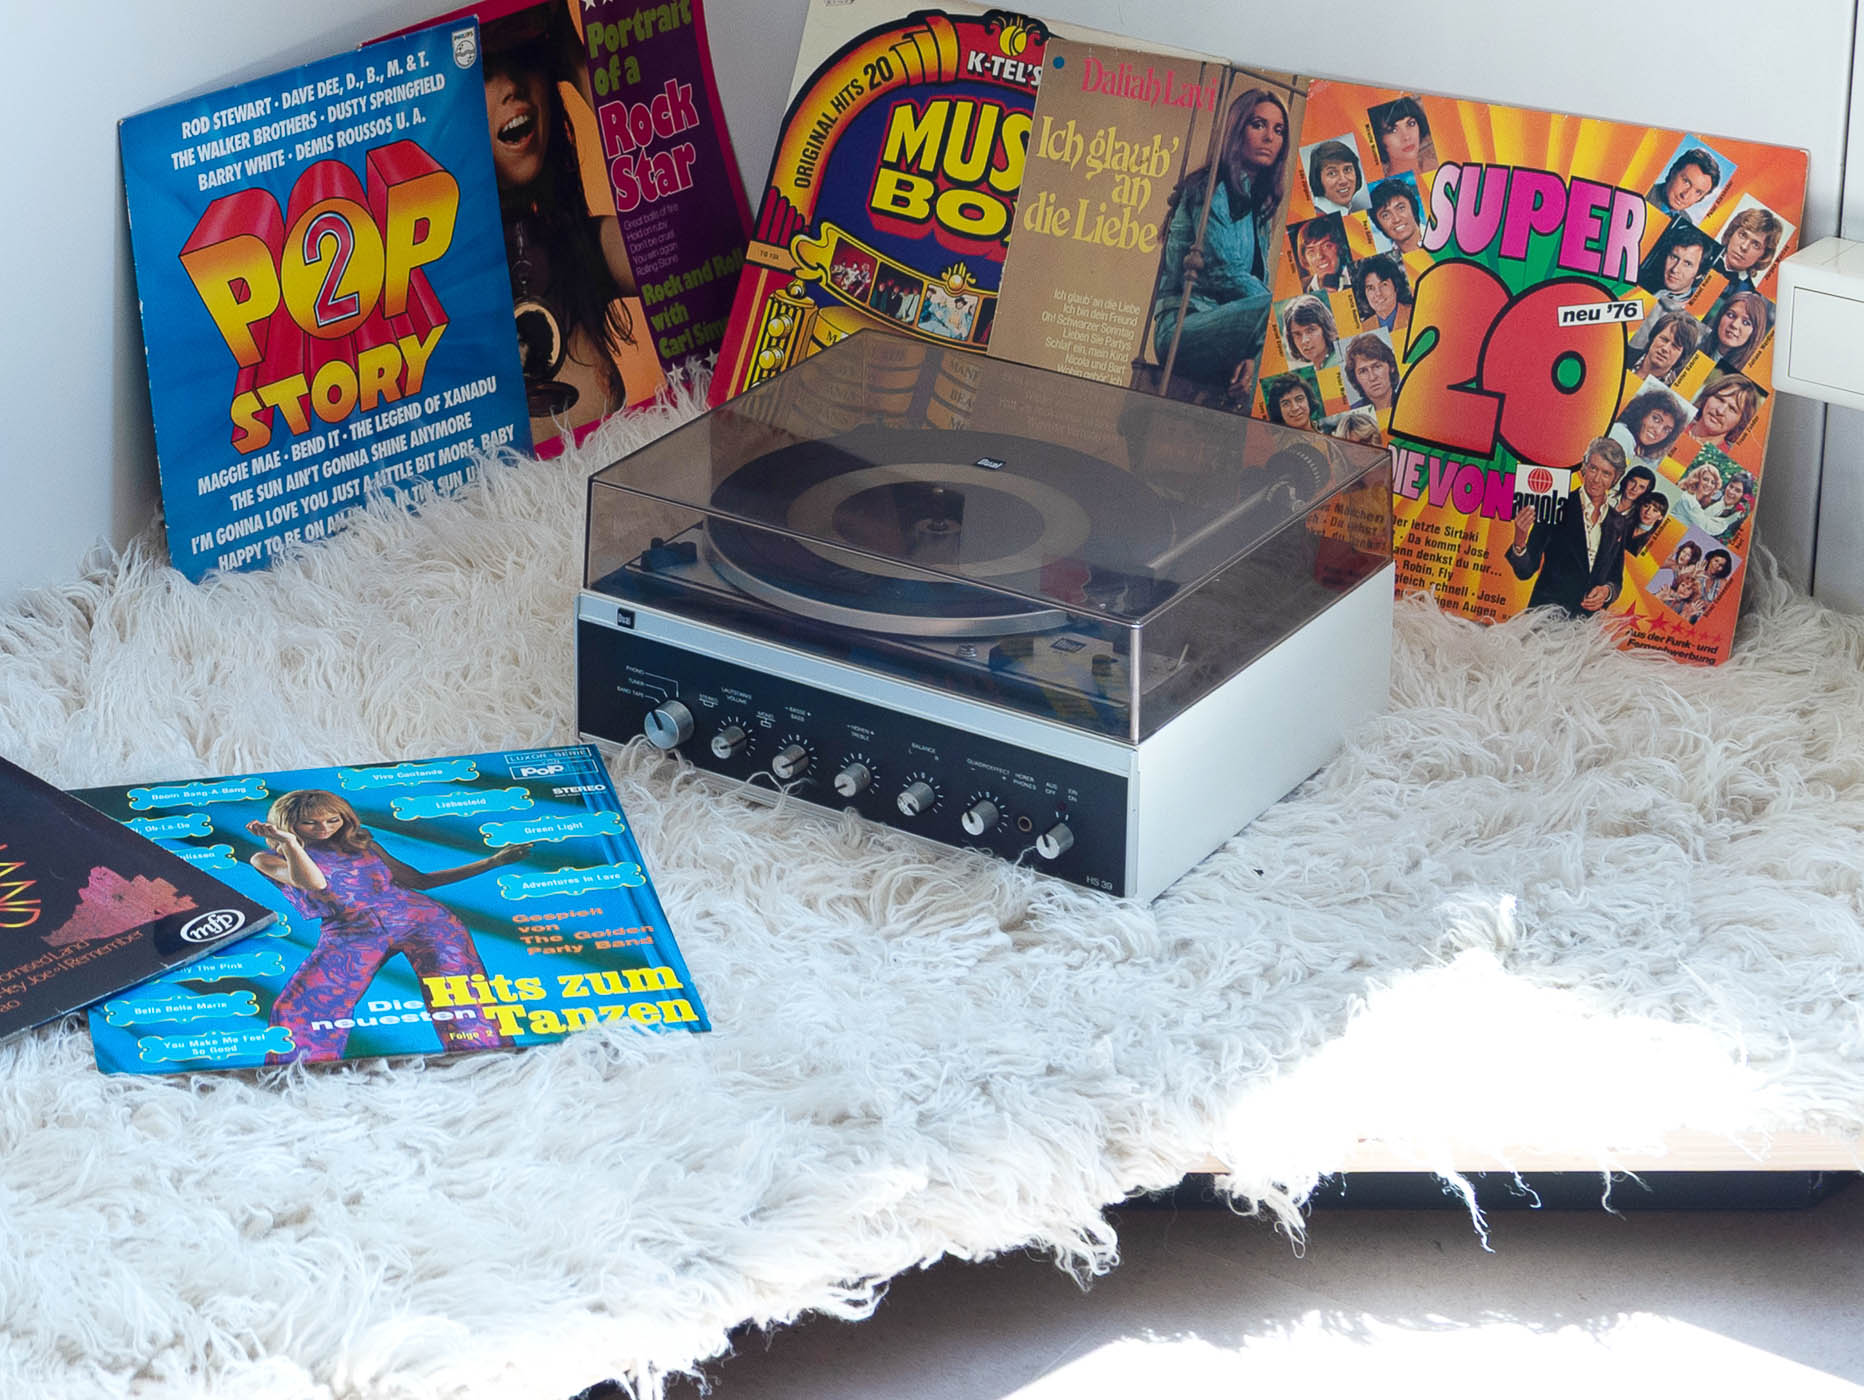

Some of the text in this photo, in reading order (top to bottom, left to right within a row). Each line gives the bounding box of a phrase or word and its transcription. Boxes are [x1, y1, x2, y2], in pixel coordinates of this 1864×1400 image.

[594, 55, 641, 96] of a
[968, 50, 1042, 87] K-TEL'S
[181, 52, 430, 139] ROD STEWART DAVE DEE, D., B., M. T.
[1081, 56, 1217, 112] Daliah Lavi
[171, 73, 445, 170] THE WALKER BROTHERS DUSTY SPRINGFIELD
[599, 78, 699, 159] Rock
[794, 56, 894, 189] ORIGINAL HITS 20
[198, 107, 426, 191] BARRY WHITE DEMIS ROUSSOS U. A.
[883, 100, 1033, 193] MUS
[1037, 116, 1180, 181] Ich glaub'
[611, 142, 696, 212] Star
[869, 166, 1018, 242] BO
[1112, 174, 1151, 214] an
[1023, 192, 1158, 253] die Liebe
[1421, 162, 1647, 285] SUPER
[179, 142, 460, 368] POP
[302, 211, 361, 328] 2
[641, 248, 745, 306] Rock and Roll
[651, 302, 690, 332] with
[1063, 303, 1138, 326] Ich dein Freund
[1118, 302, 1140, 315] Liebe
[1562, 302, 1638, 323] neu '76
[1057, 314, 1134, 340] Schwarzer Sonntag
[1063, 328, 1104, 344] Lieben Sie
[658, 330, 694, 359] Carl
[1088, 347, 1128, 362] mein Kind
[1064, 354, 1105, 370] Nicola und
[1388, 257, 1628, 468] 20
[231, 322, 449, 455] STORY
[198, 376, 497, 496] MAGGIE MAE BEND IT THE LEGEND OF XANADU
[230, 412, 473, 511] THE SUN AIN'T GONNA SHINE ANYMORE
[1428, 456, 1515, 520] VON
[191, 455, 435, 554] I'M GONNA LOVE YOU JUST A LITTLE BIT
[218, 470, 462, 572] HAPPY TO ON SUN
[1411, 520, 1479, 542] letzte Sirtaki
[1408, 534, 1420, 545] Da
[1424, 538, 1460, 555] kommt
[1402, 560, 1453, 581] Robin, Fly
[1416, 549, 1469, 569] denkst du
[1394, 574, 1425, 589] gleich
[1477, 590, 1506, 606] Josie
[1462, 603, 1497, 619] Augen
[1626, 628, 1719, 654] Aus der Funk- und
[152, 792, 179, 800] Boom
[552, 784, 606, 794] STEREO
[436, 798, 486, 809] Liebesleid
[524, 822, 584, 834] Green Light
[522, 872, 620, 889] Adventures Love
[1086, 876, 1112, 890] HS 39
[190, 912, 234, 940] mfp
[512, 908, 603, 922] Gespielt
[518, 924, 559, 932] von
[520, 925, 654, 944] The Golden
[527, 937, 654, 956] Party Band
[197, 962, 243, 971] The Pink
[422, 966, 683, 1007] Hits zum
[134, 1001, 227, 1015] Bella Bella Marie
[311, 999, 698, 1037] neuesten Tanzen
[368, 1000, 424, 1013] Die
[163, 1039, 218, 1050] You Make
[210, 1045, 237, 1054] Good
[449, 1031, 479, 1041] Folge
